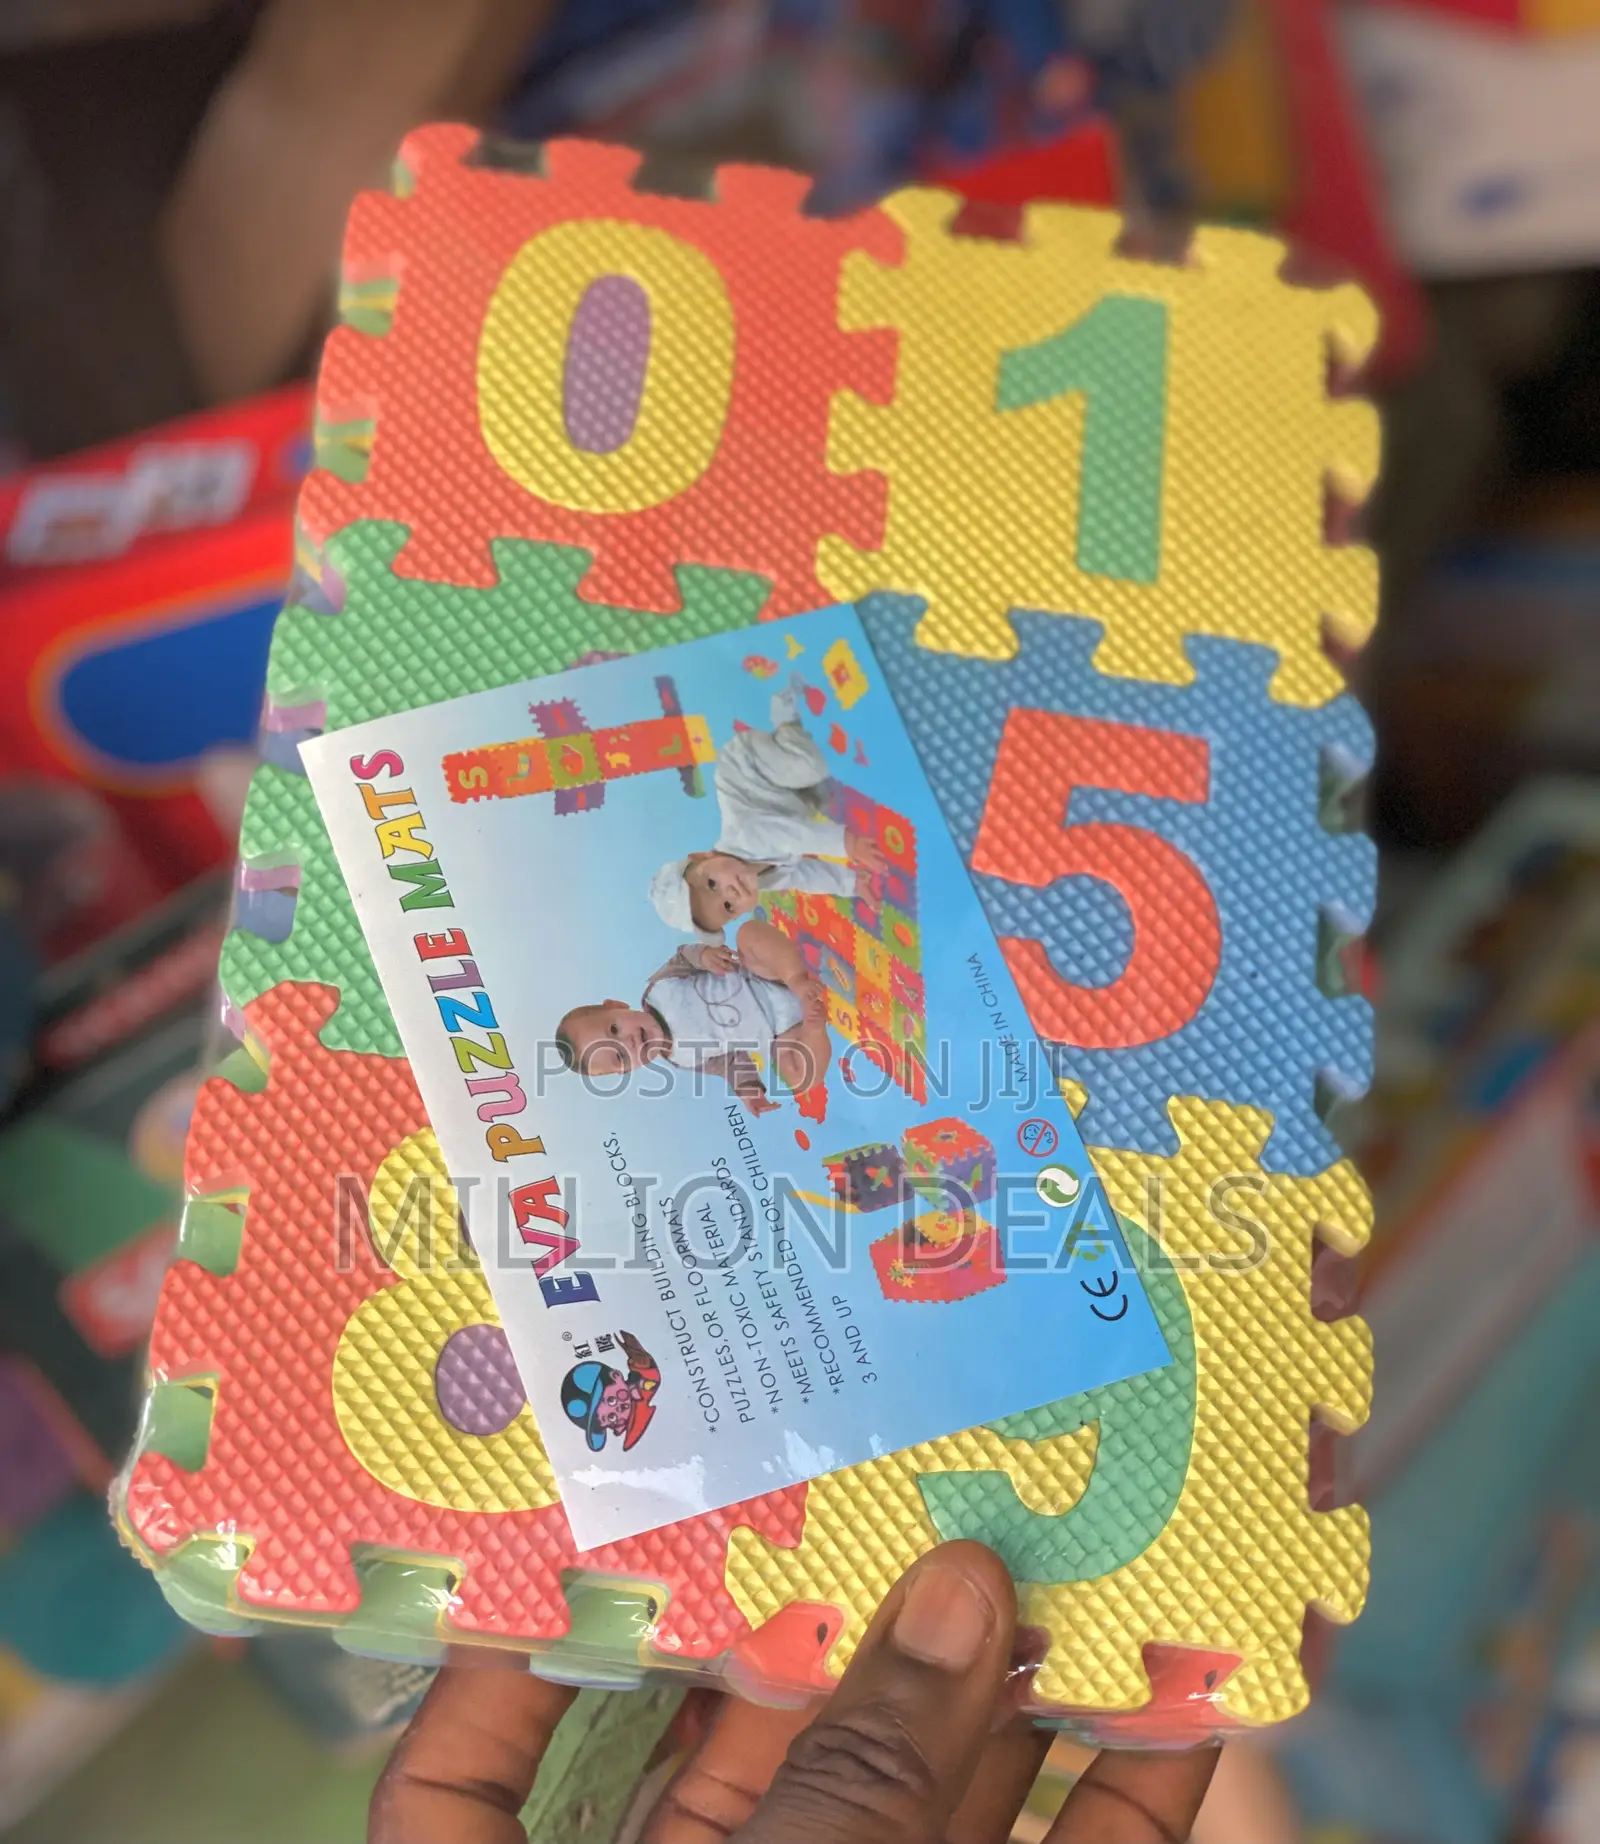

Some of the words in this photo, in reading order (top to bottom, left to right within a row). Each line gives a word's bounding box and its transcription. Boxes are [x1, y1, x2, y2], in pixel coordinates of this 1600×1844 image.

[477, 217, 736, 514] 0
[995, 291, 1171, 585] 1
[350, 749, 455, 913] MATS
[972, 706, 1222, 1050] 5
[966, 952, 998, 1008] CHINA
[990, 1011, 1009, 1031] IN
[413, 927, 547, 1163] PUZZLE
[998, 1033, 1029, 1083] MADE
[724, 1104, 768, 1191] CHILDREN
[508, 1175, 601, 1309] EVA
[659, 1197, 712, 1306] FLOORMATS
[697, 1202, 739, 1286] MATERIAL
[711, 1157, 763, 1261] STANDARDS
[760, 1196, 784, 1232] FOR
[632, 1213, 675, 1301] BUILDING
[753, 1270, 789, 1330] SAFETY
[832, 1296, 852, 1318] UP
[845, 1326, 871, 1364] AND
[861, 1371, 878, 1384] 3
